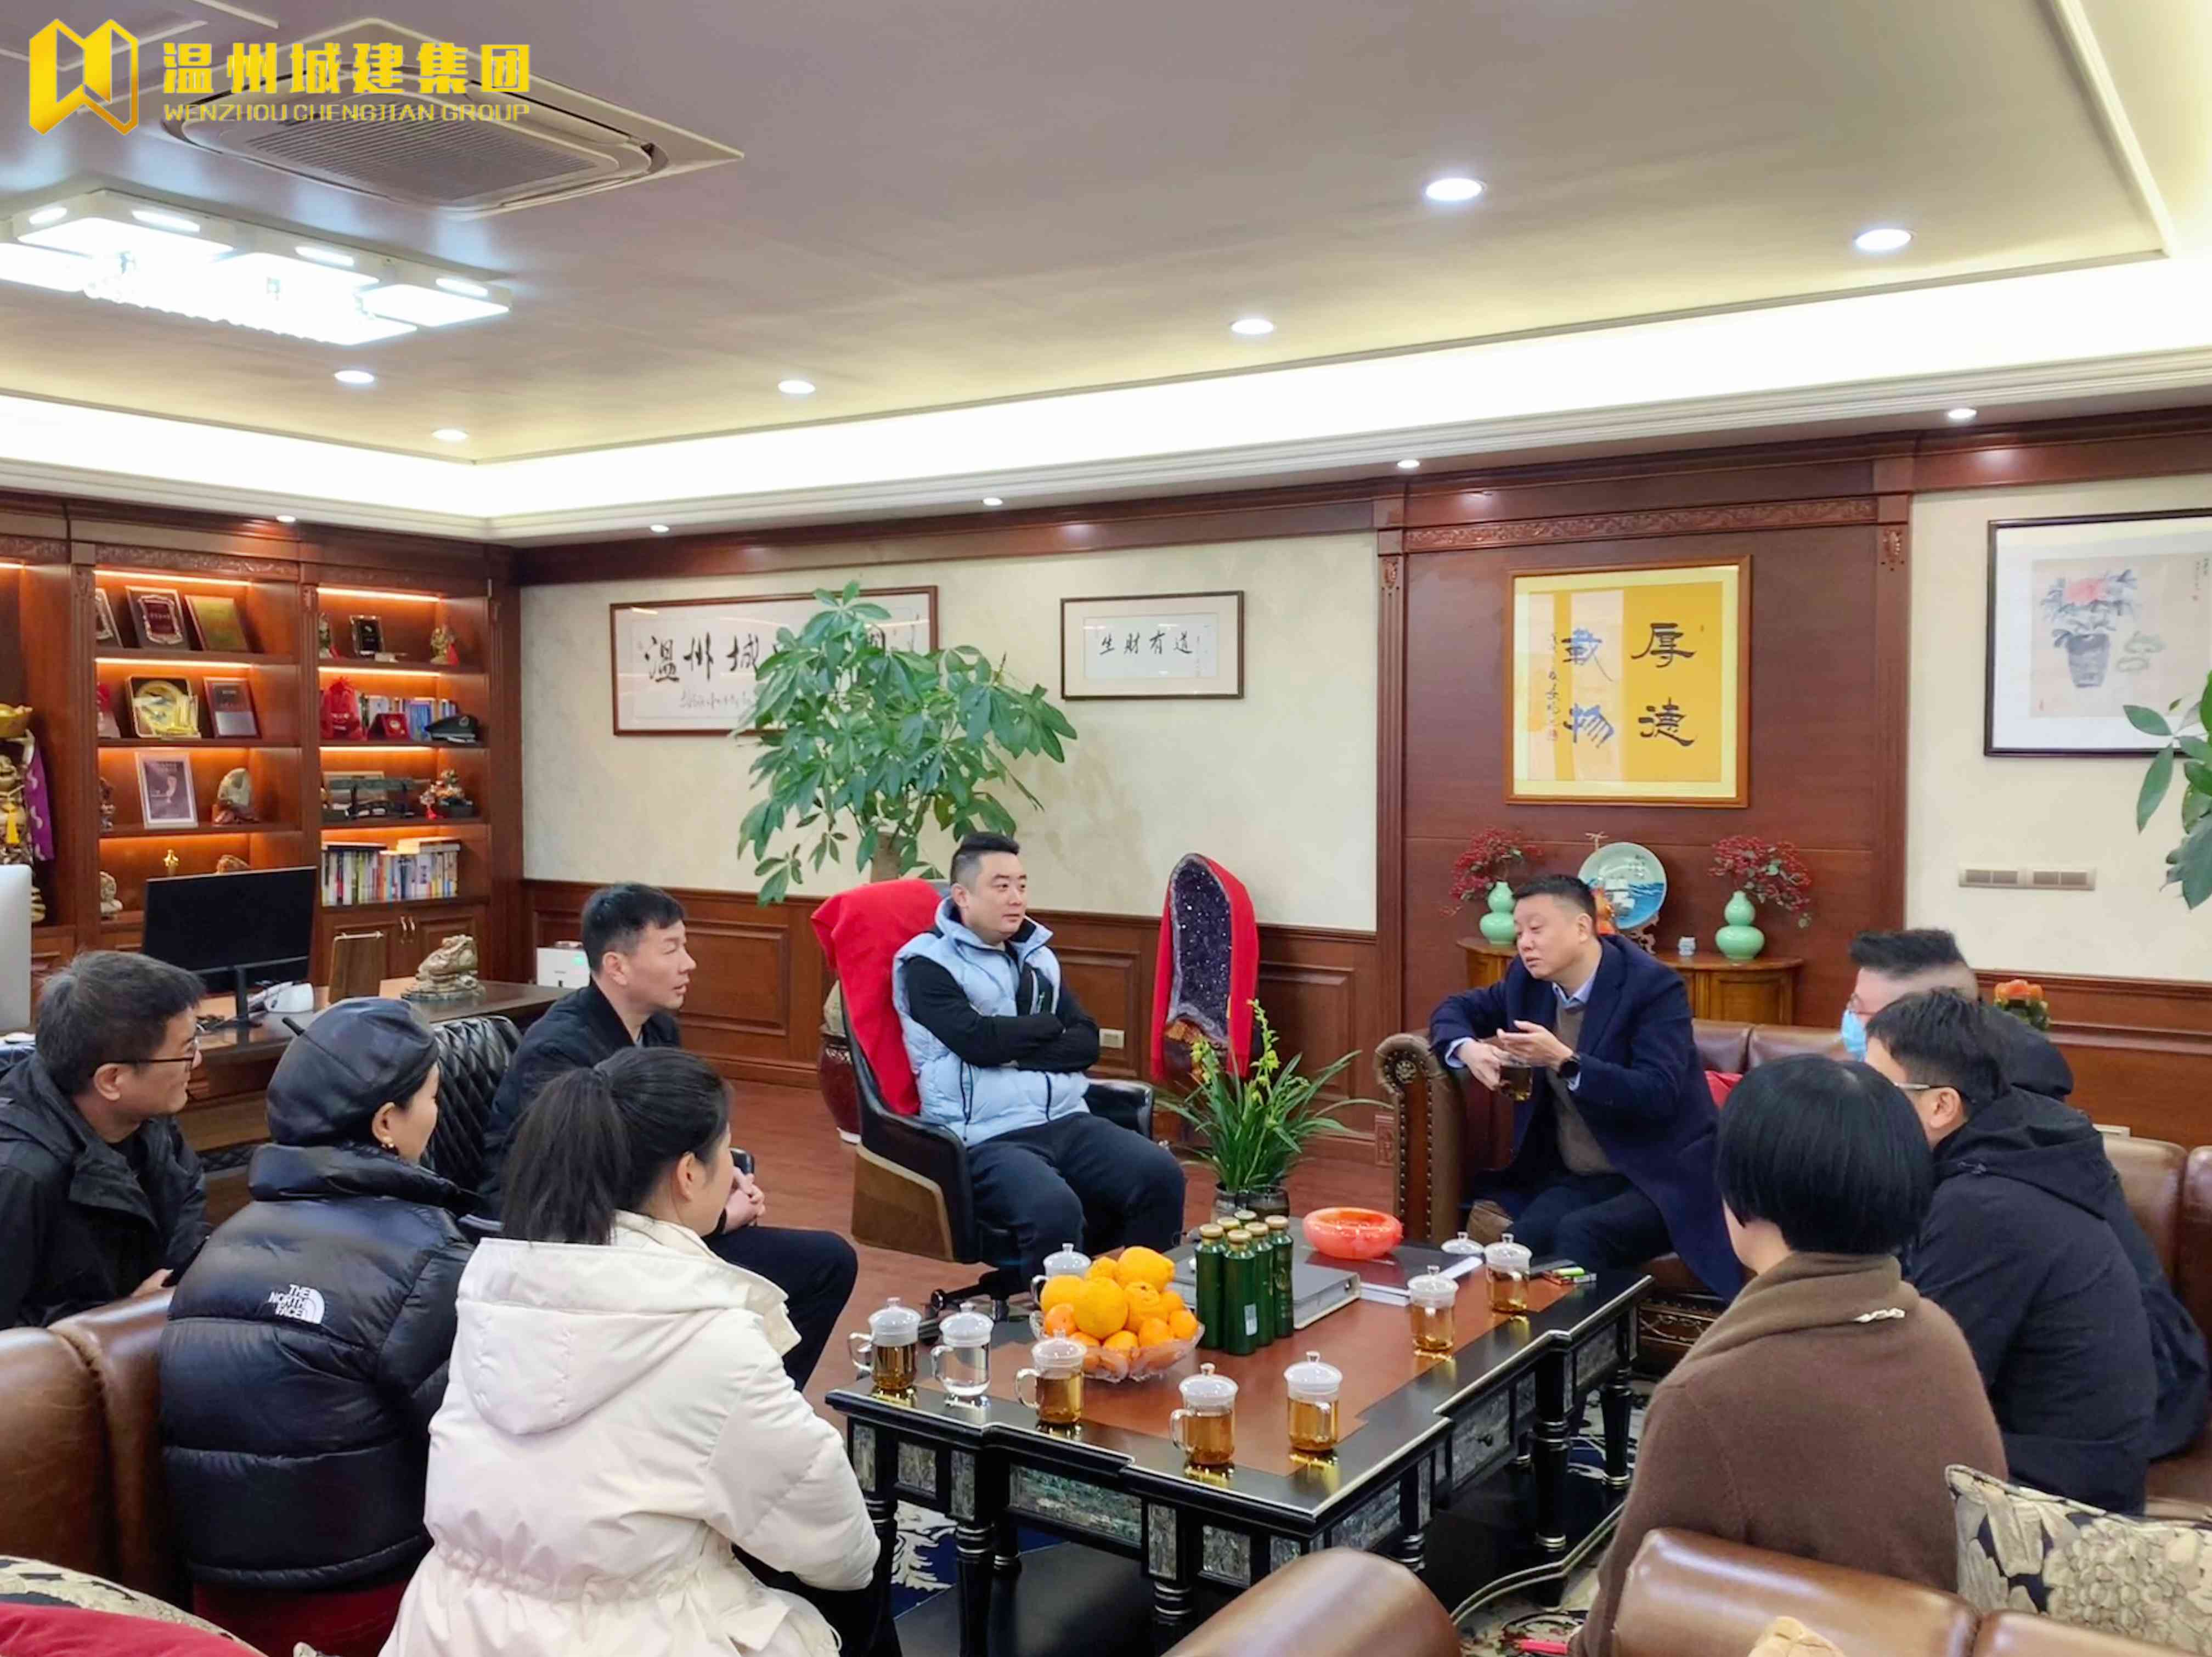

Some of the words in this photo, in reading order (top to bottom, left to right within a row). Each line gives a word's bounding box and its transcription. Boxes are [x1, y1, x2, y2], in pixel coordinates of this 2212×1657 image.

[644, 631, 778, 682] 温州城
[289, 1283, 311, 1299] THE
[268, 1291, 304, 1309] NORTH
[275, 1303, 303, 1318] FACE
